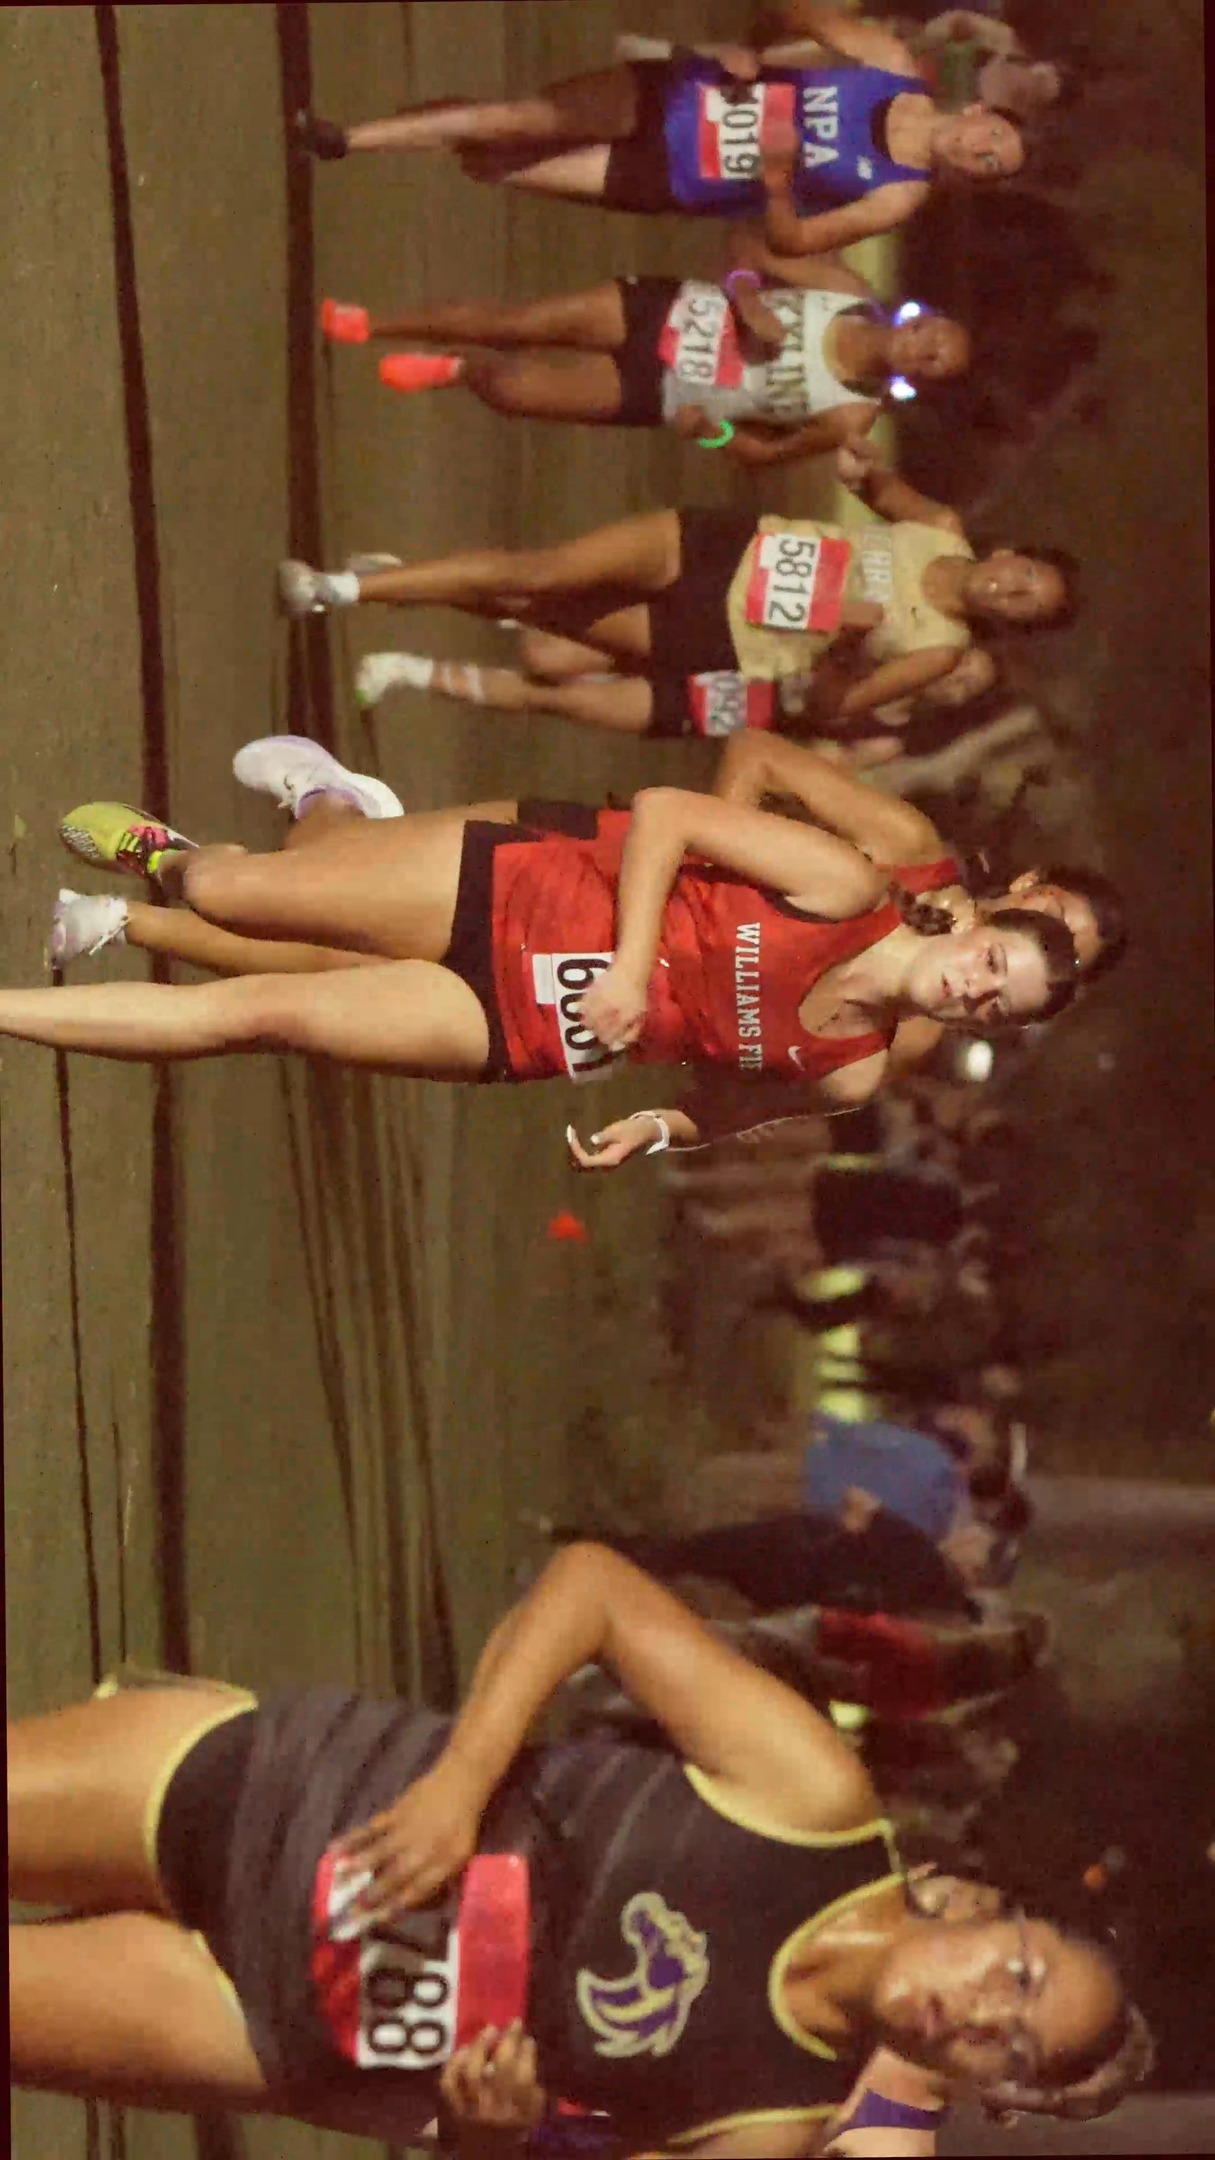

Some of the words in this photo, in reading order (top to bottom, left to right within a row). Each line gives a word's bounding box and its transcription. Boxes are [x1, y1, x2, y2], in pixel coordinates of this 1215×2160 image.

[802, 85, 839, 169] NPA
[680, 299, 720, 379] 5218
[767, 539, 815, 623] 5812
[735, 922, 762, 1038] WILLIAMS
